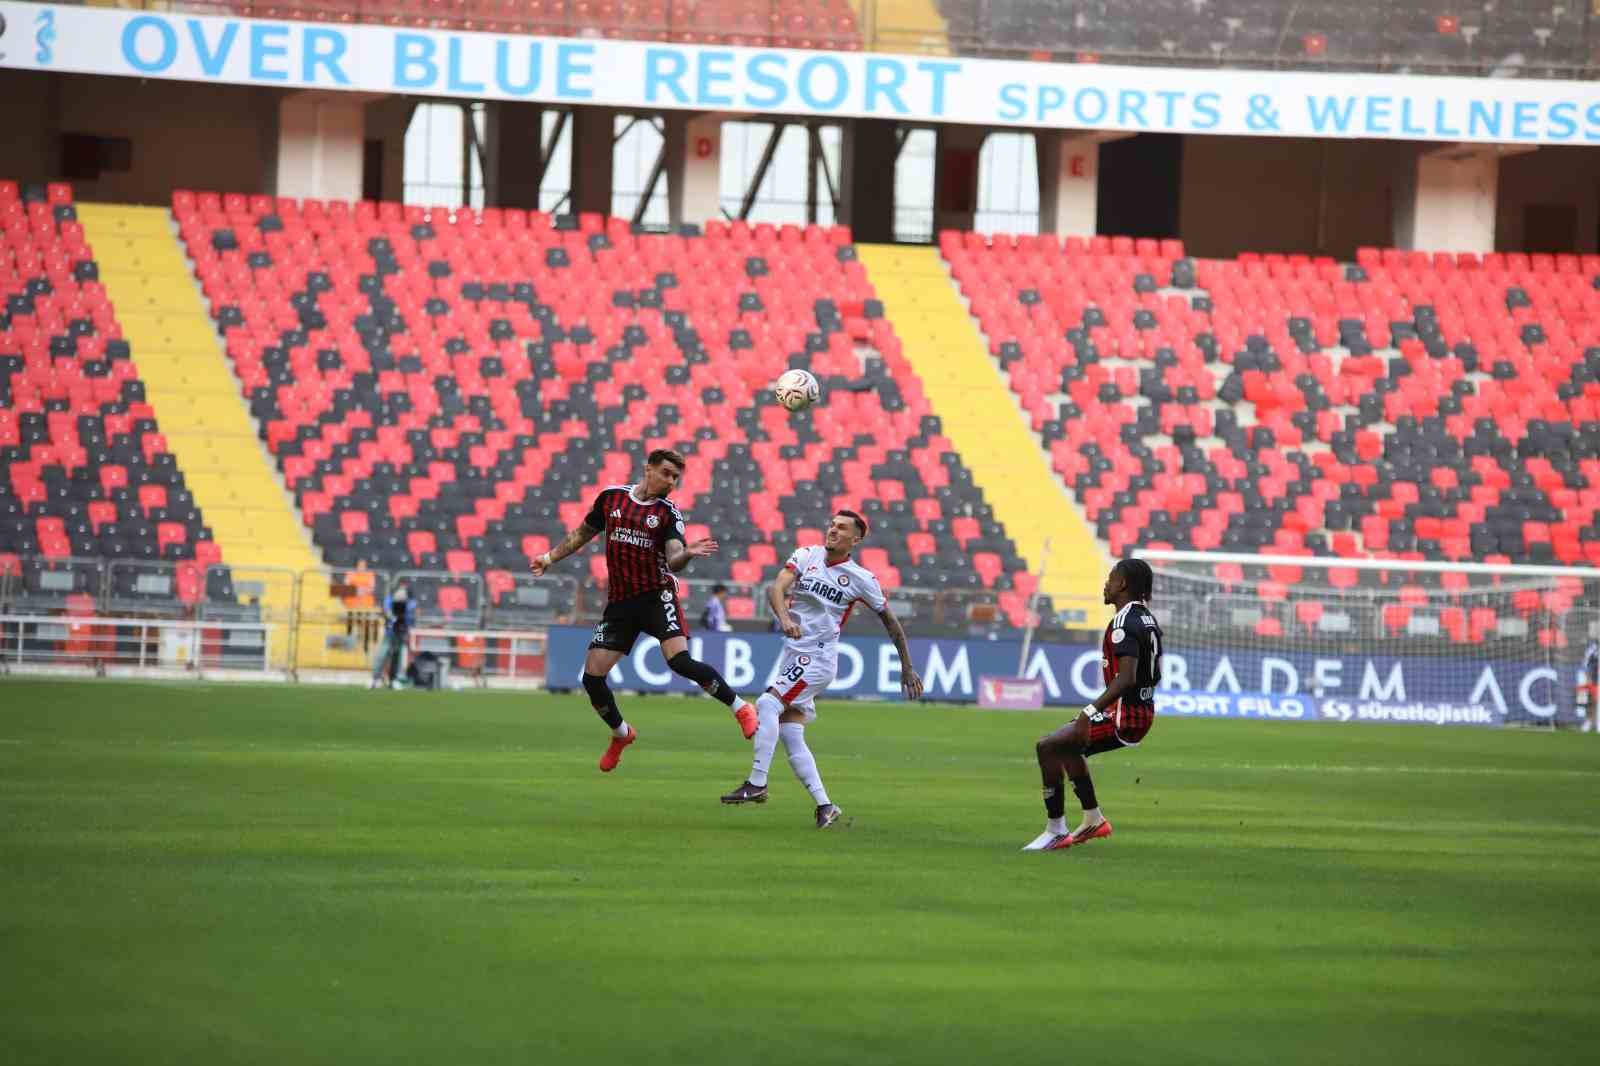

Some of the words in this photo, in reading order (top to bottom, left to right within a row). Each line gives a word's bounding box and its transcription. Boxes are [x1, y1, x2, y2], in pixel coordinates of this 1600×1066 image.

[121, 15, 349, 84] OVER
[393, 33, 596, 99] BLUE
[644, 47, 963, 116] RESORT
[998, 83, 1222, 129] SPORTS
[1245, 93, 1280, 131] &
[1306, 95, 1600, 141] WELLNESS
[810, 581, 844, 604] ARCA
[1025, 647, 1407, 702] ACBADEM
[1153, 692, 1231, 716] PORT
